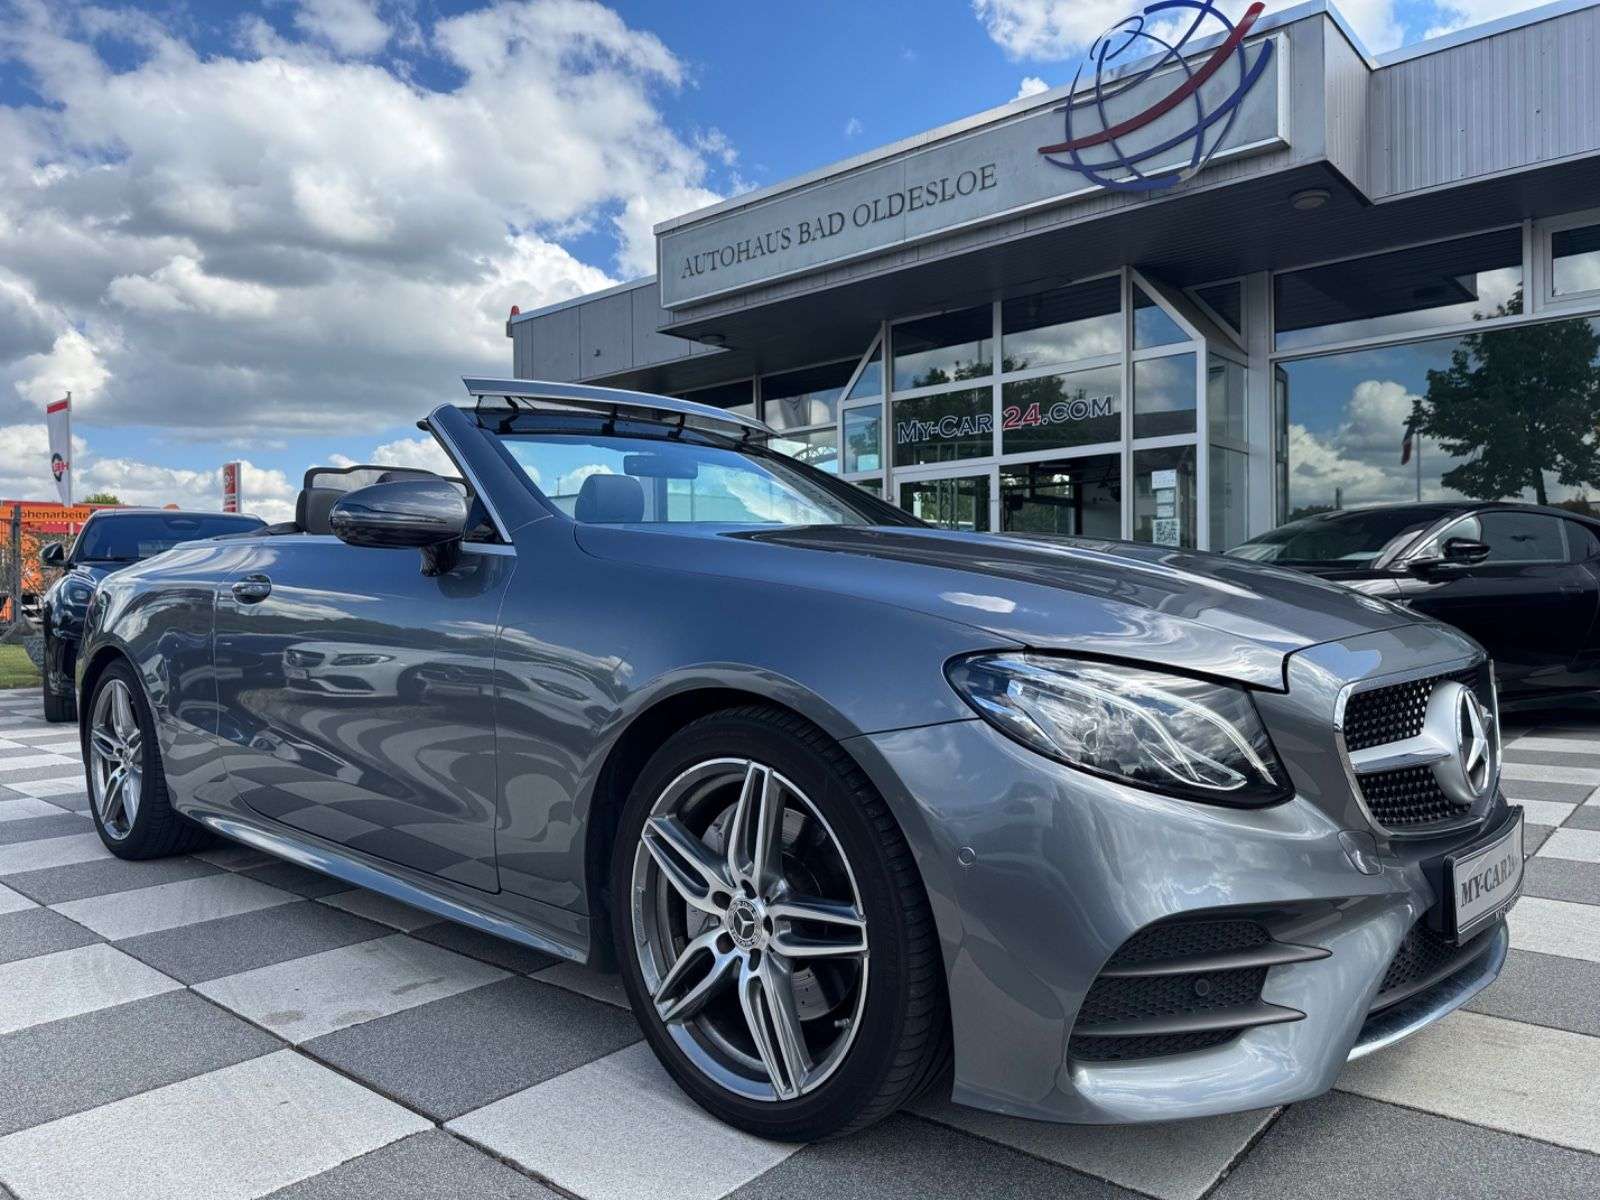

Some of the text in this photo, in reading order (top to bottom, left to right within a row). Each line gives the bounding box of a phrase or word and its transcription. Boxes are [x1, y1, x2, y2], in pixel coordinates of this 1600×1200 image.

[680, 162, 998, 279] AUTOHAUS BAD OLDESLOE
